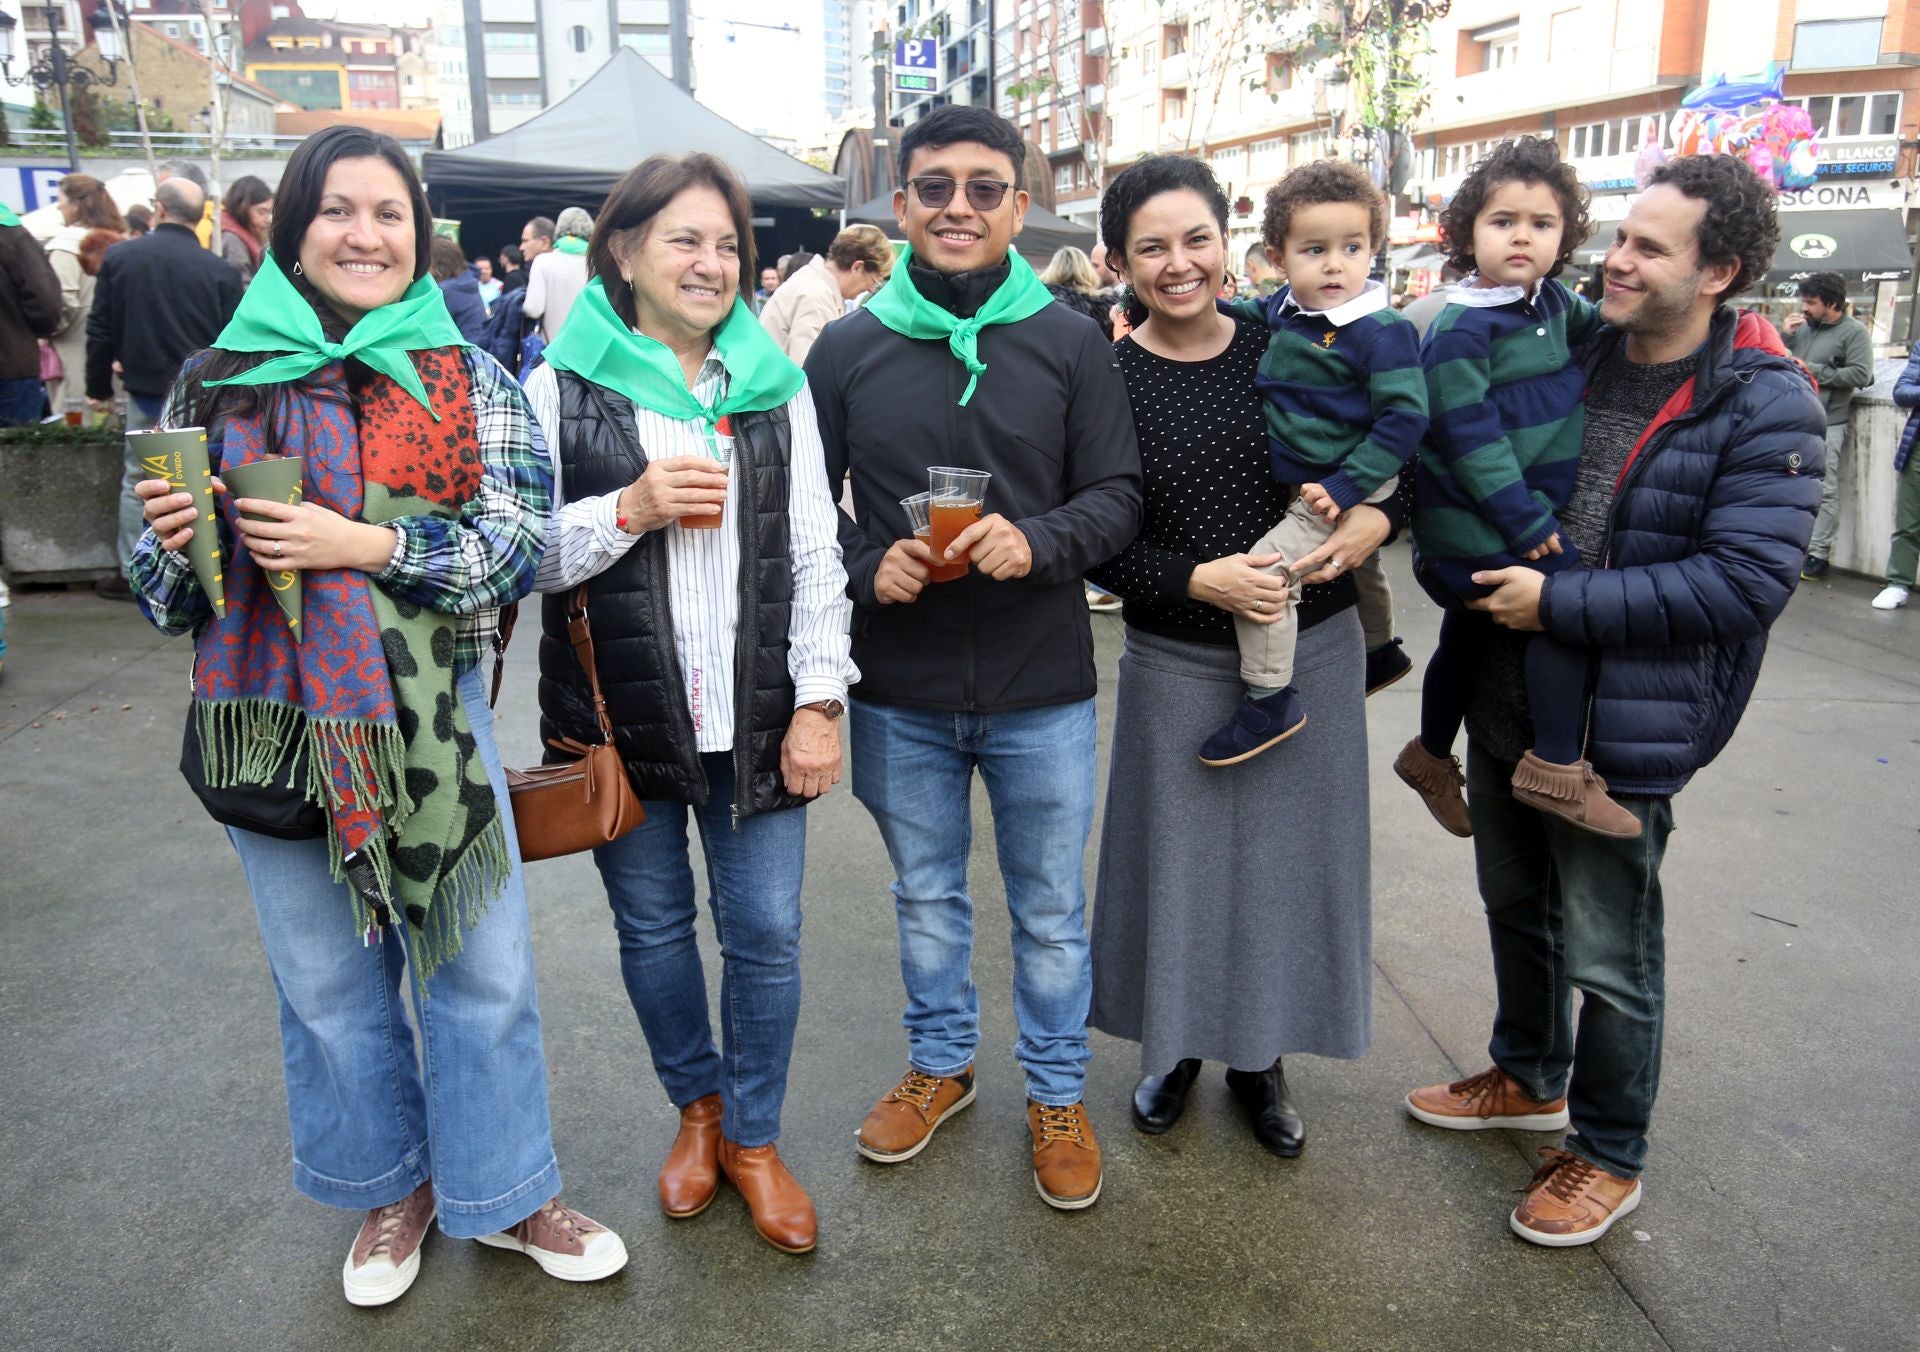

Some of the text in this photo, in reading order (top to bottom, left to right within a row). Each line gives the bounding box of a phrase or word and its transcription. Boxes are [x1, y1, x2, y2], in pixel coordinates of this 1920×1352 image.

[904, 39, 922, 65] P
[900, 76, 929, 89] LIBRE
[1837, 145, 1897, 160] BLANCO
[1830, 164, 1844, 174] DE
[1845, 162, 1894, 174] SEGUROS
[174, 451, 183, 480] OVIEDO
